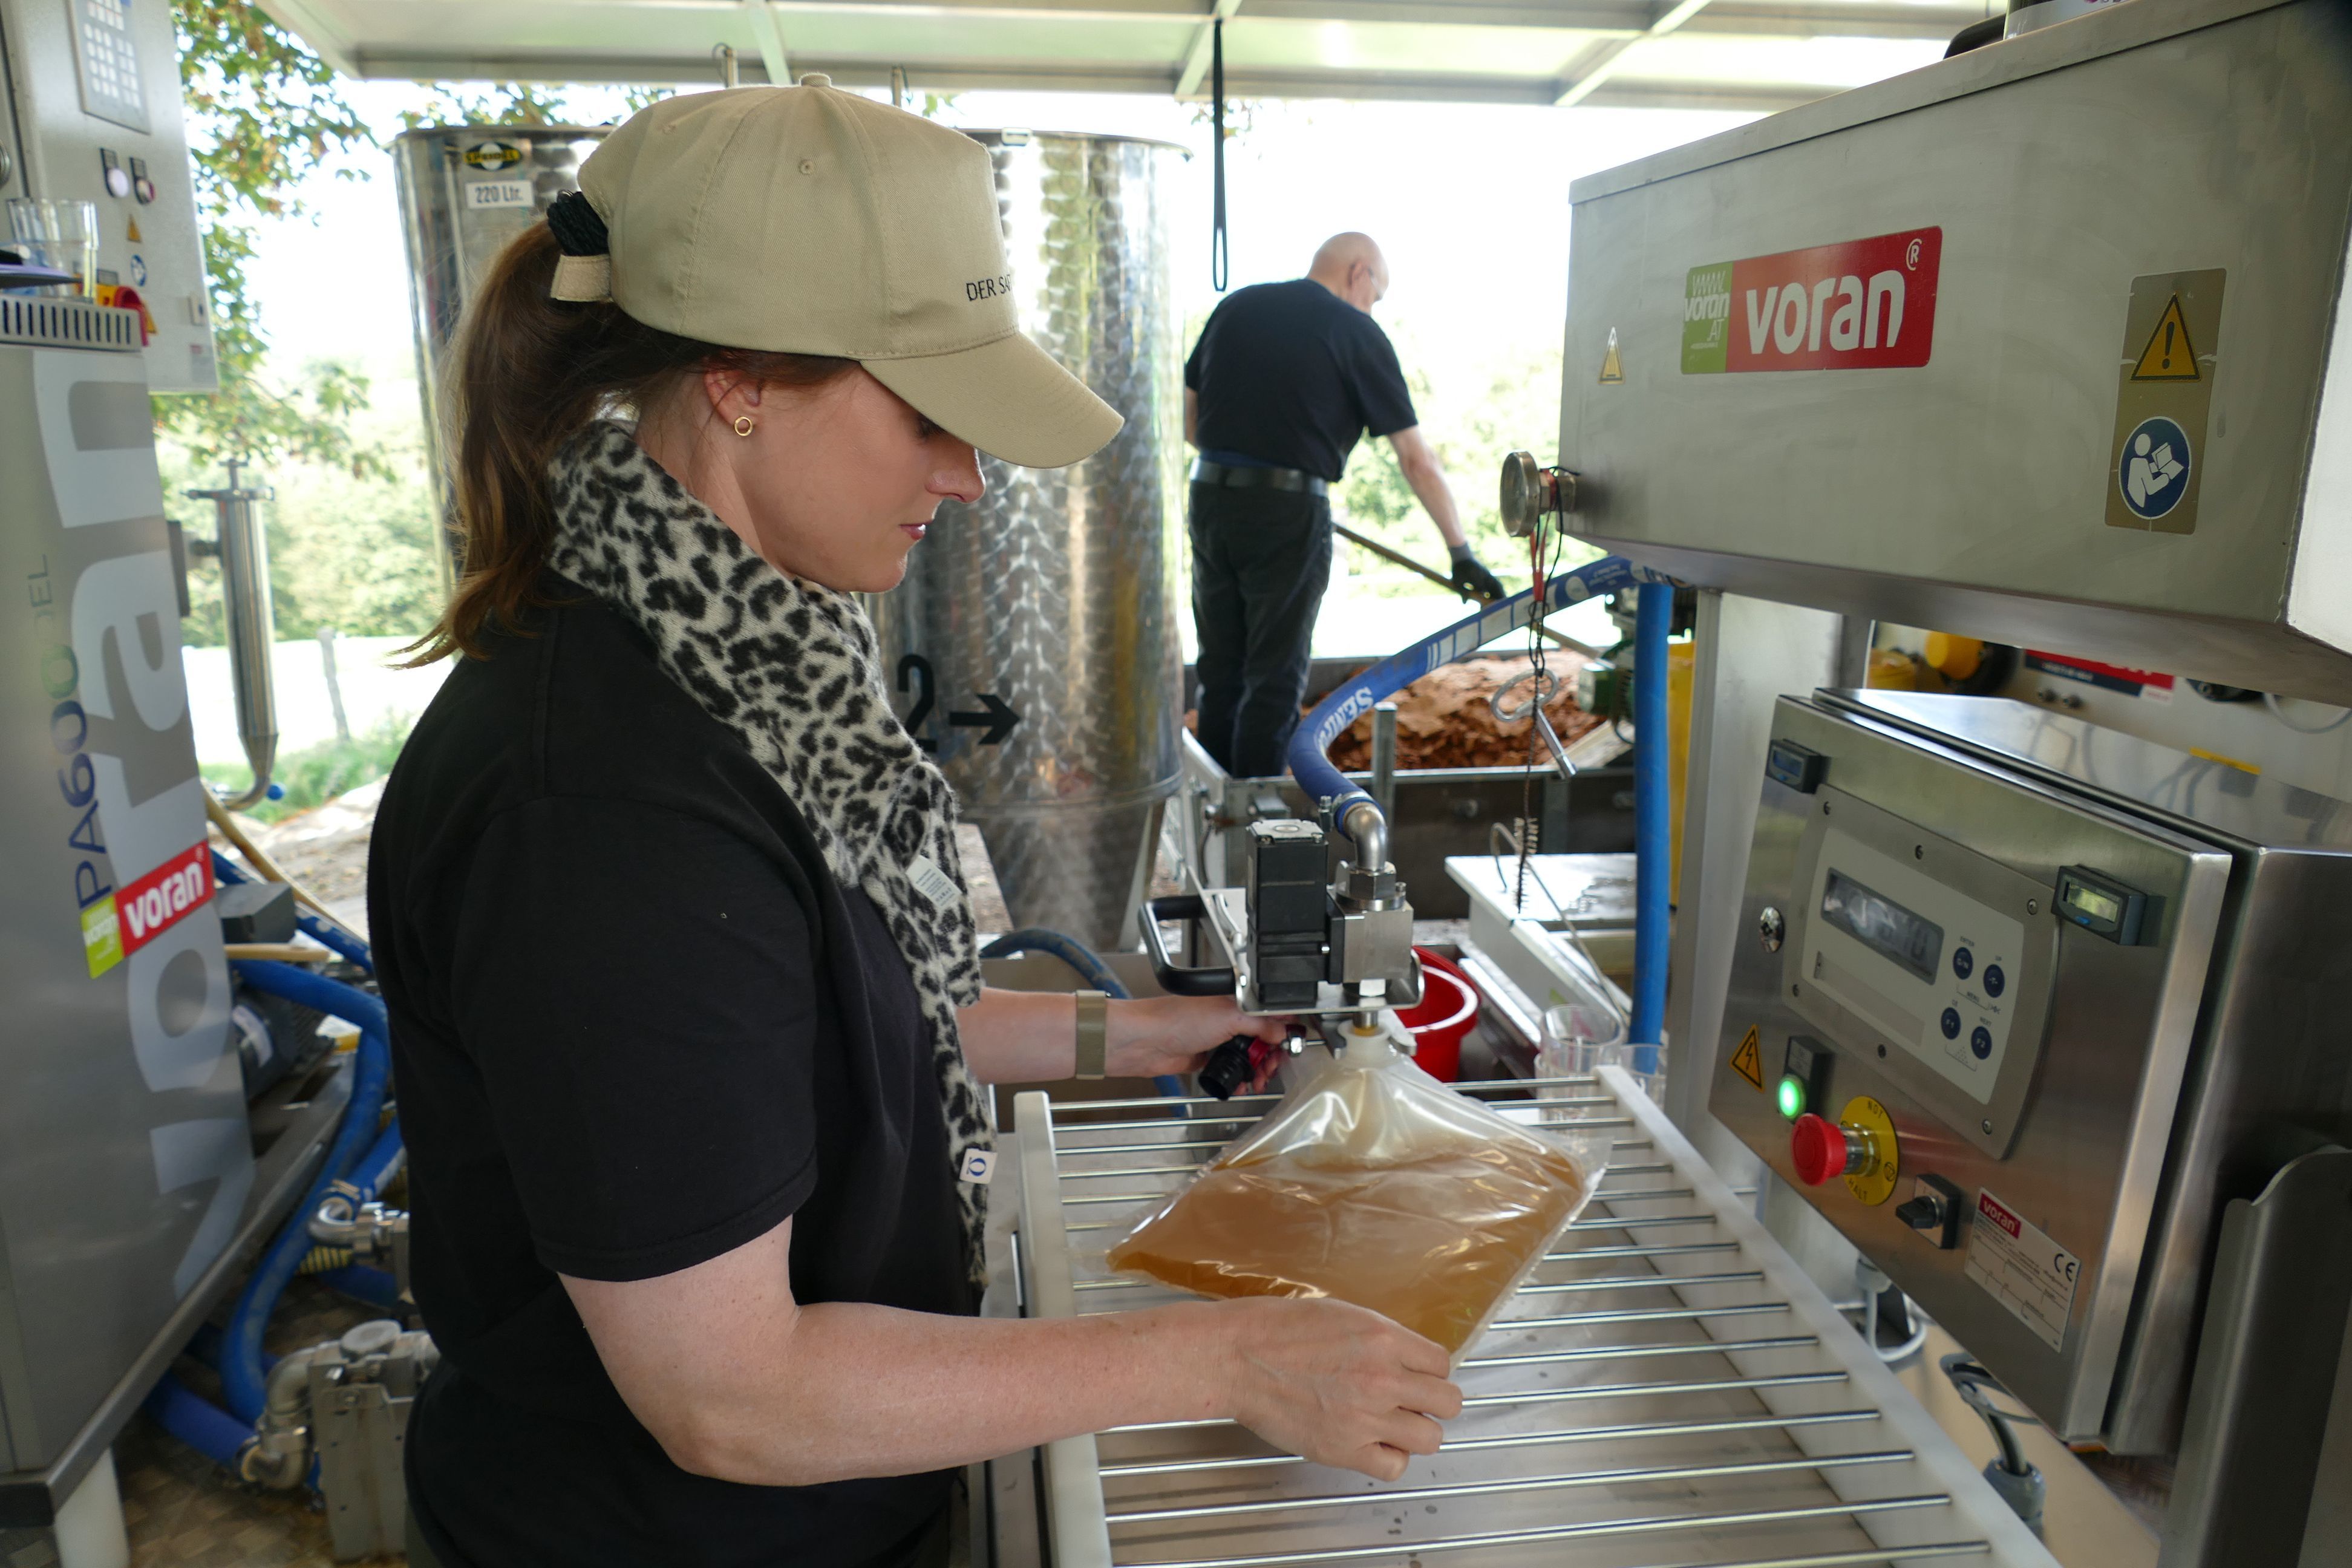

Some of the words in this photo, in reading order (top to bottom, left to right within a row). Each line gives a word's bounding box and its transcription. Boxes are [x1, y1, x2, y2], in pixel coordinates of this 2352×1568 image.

[475, 185, 500, 203] 220
[966, 278, 997, 301] DER
[1684, 292, 1731, 322] voran
[1746, 269, 1905, 354] voran
[898, 655, 938, 752] 2
[124, 861, 205, 939] voran
[1976, 1037, 1986, 1049] F2
[1867, 1100, 1884, 1119] NOT
[1848, 1178, 1867, 1201] HALT
[1984, 1200, 2015, 1233] voran
